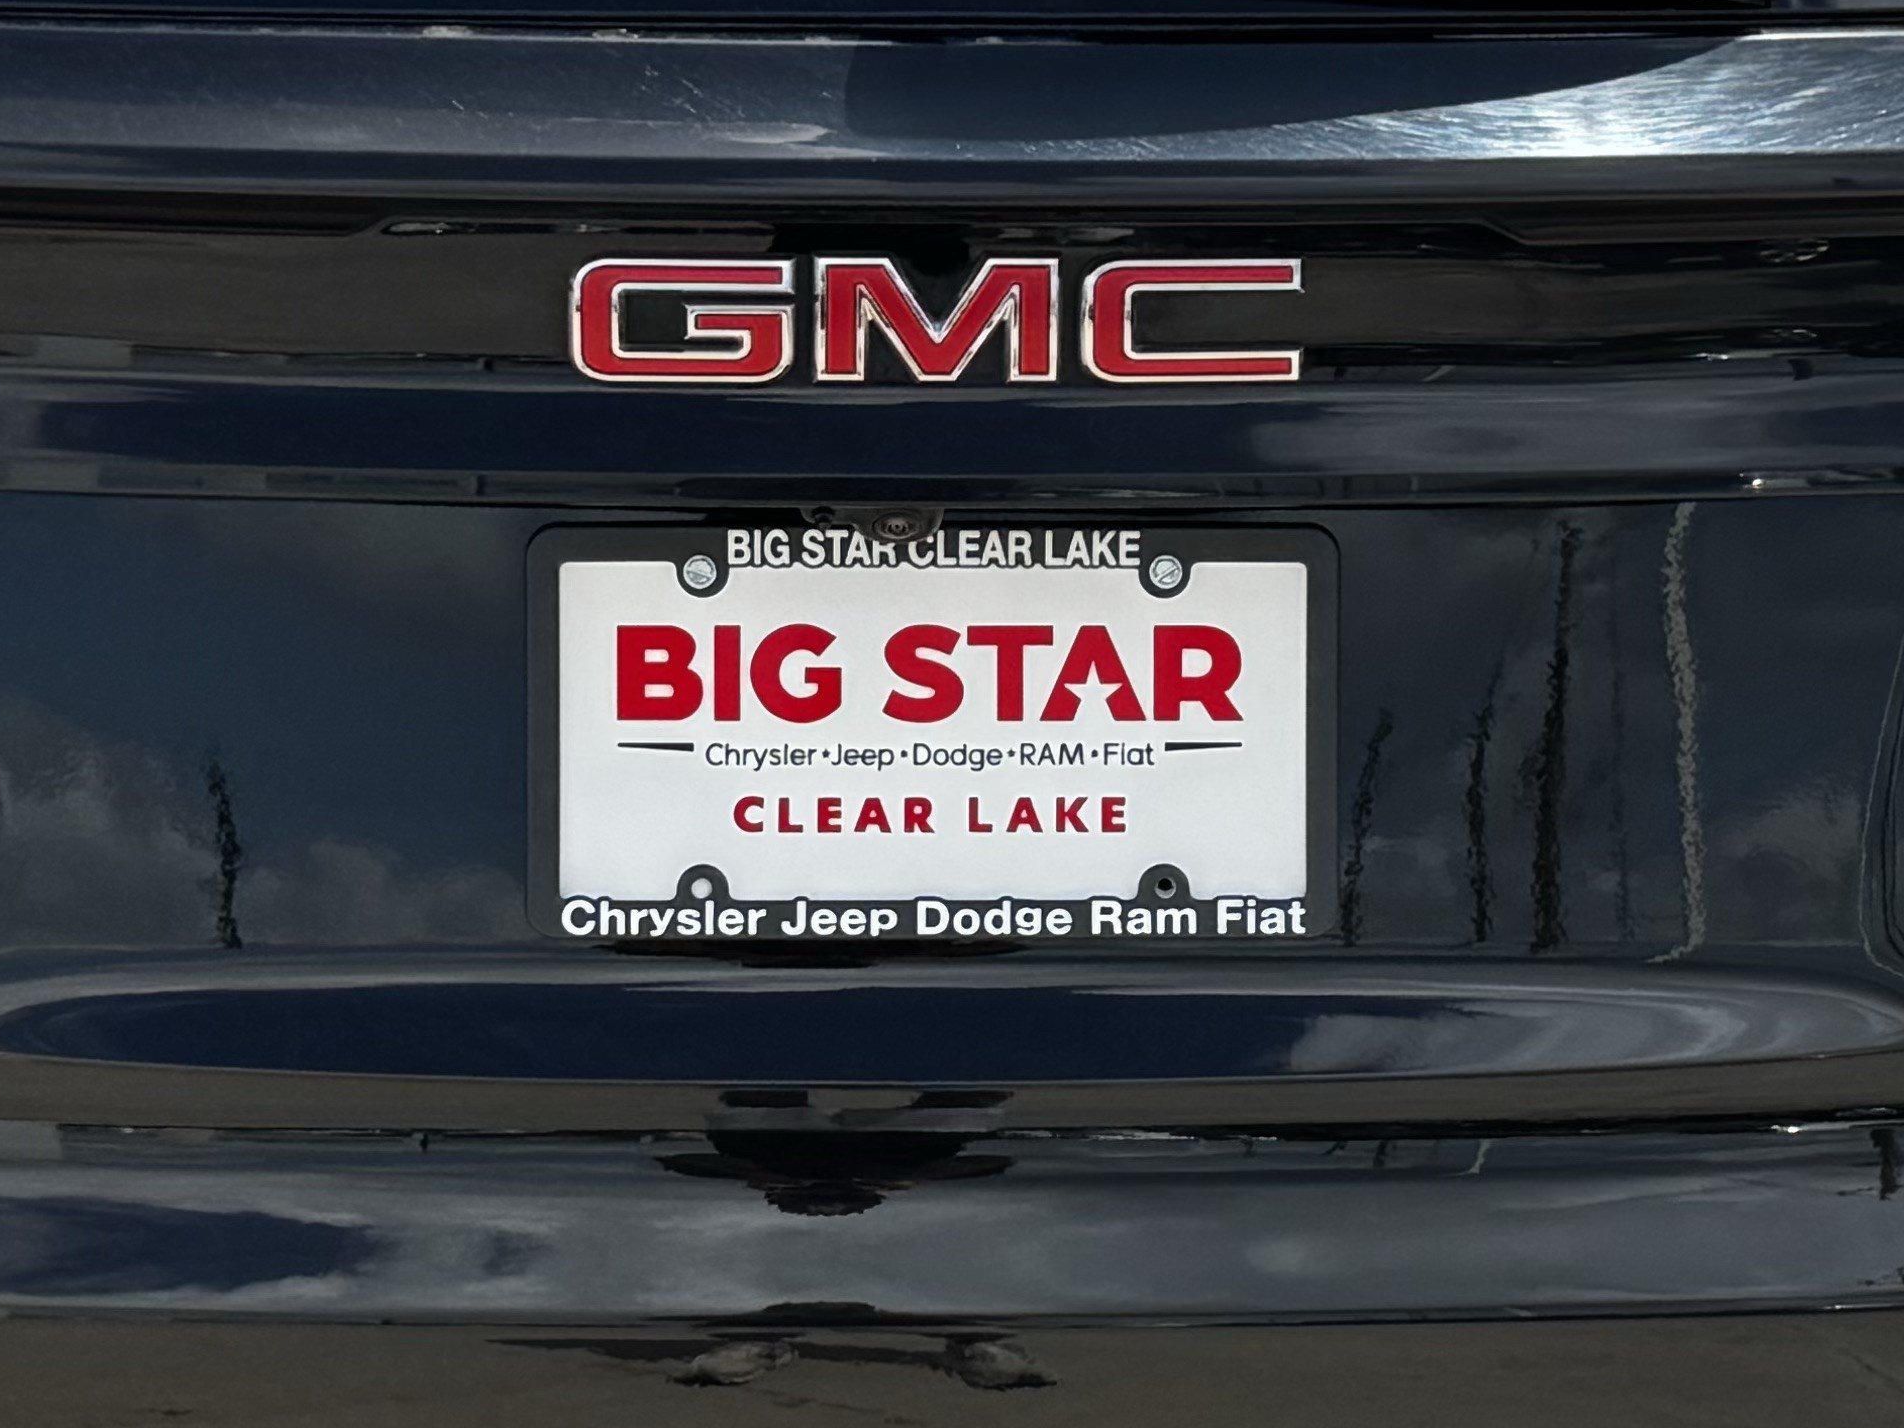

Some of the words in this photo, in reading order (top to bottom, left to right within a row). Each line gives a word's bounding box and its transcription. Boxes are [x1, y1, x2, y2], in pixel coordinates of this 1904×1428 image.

[570, 257, 1303, 383] GMC
[727, 529, 790, 566] BIG
[802, 529, 896, 566] STAR
[908, 529, 1033, 566] CLEAR
[1045, 530, 1141, 566] LAKE
[616, 623, 843, 724] BIG
[883, 623, 1244, 724] STAR
[705, 742, 817, 771] Chrysler
[831, 742, 895, 771] Jeep
[913, 742, 1003, 771] Dodge
[1019, 743, 1085, 766] RAM
[733, 796, 935, 833] CLEAR
[968, 796, 1126, 833] LAKE
[560, 899, 766, 936] Chrysler
[781, 899, 898, 936] Jeep
[917, 899, 1072, 936] Dodge
[1091, 900, 1196, 935] Ram
[1217, 896, 1307, 935] Fiat
